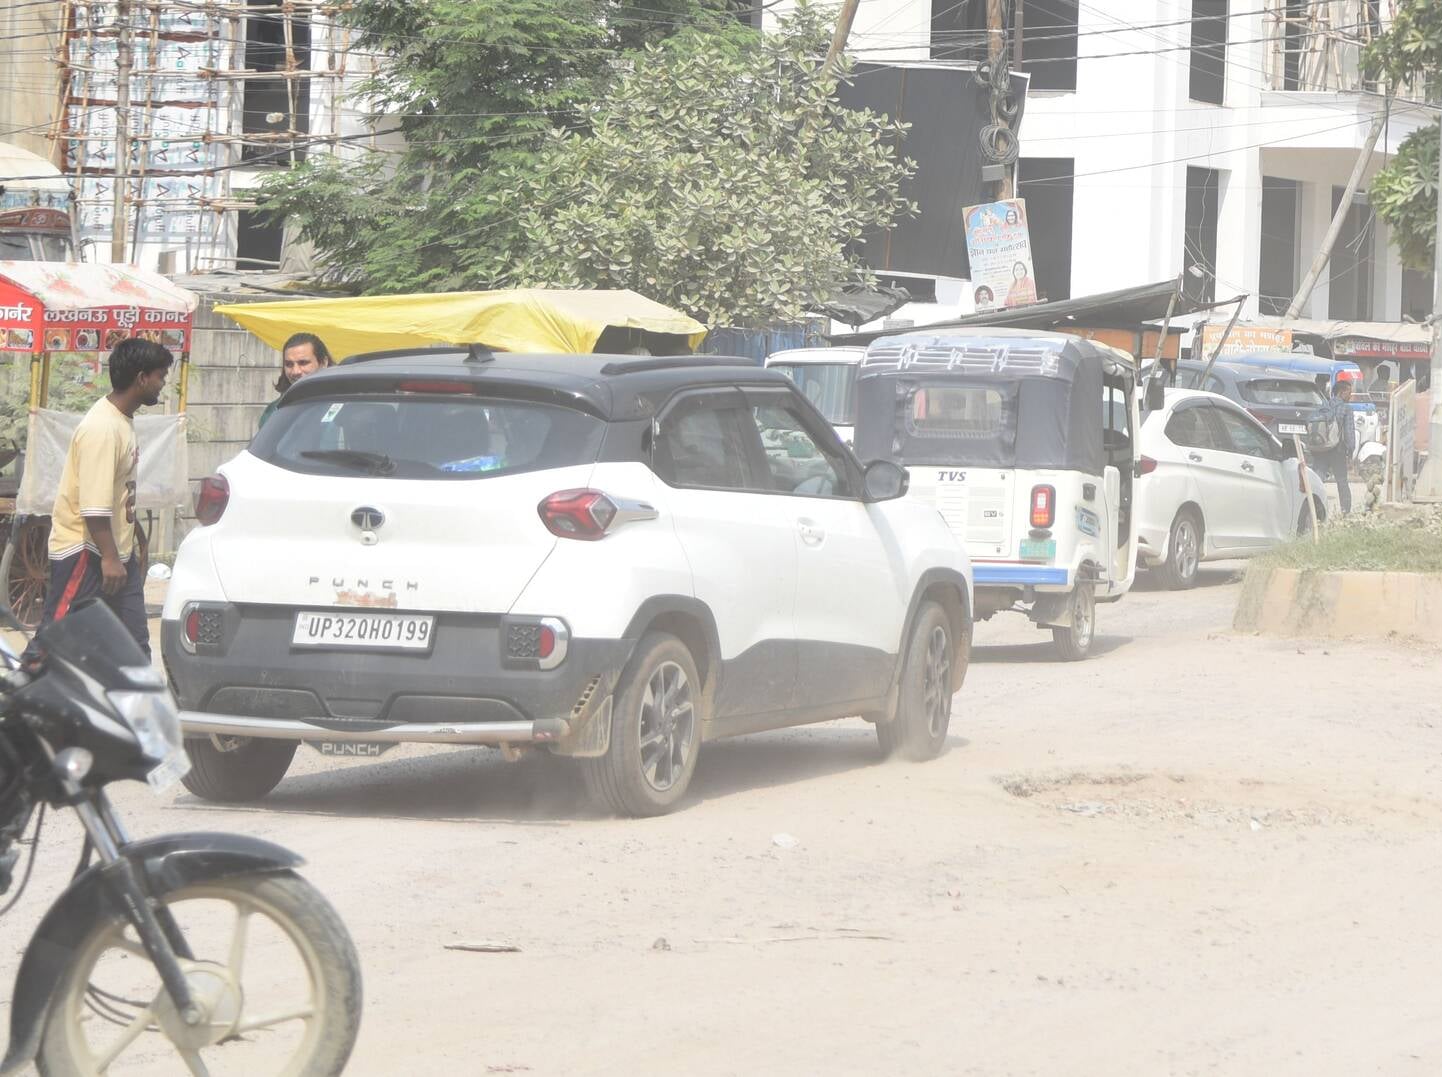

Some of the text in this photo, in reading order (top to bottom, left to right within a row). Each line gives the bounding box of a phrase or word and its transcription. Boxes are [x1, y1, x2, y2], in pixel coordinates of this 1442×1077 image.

[937, 471, 966, 481] TVS
[309, 576, 419, 590] PUNCH
[308, 616, 430, 641] UP32QH0199
[322, 743, 379, 755] PUNCH
